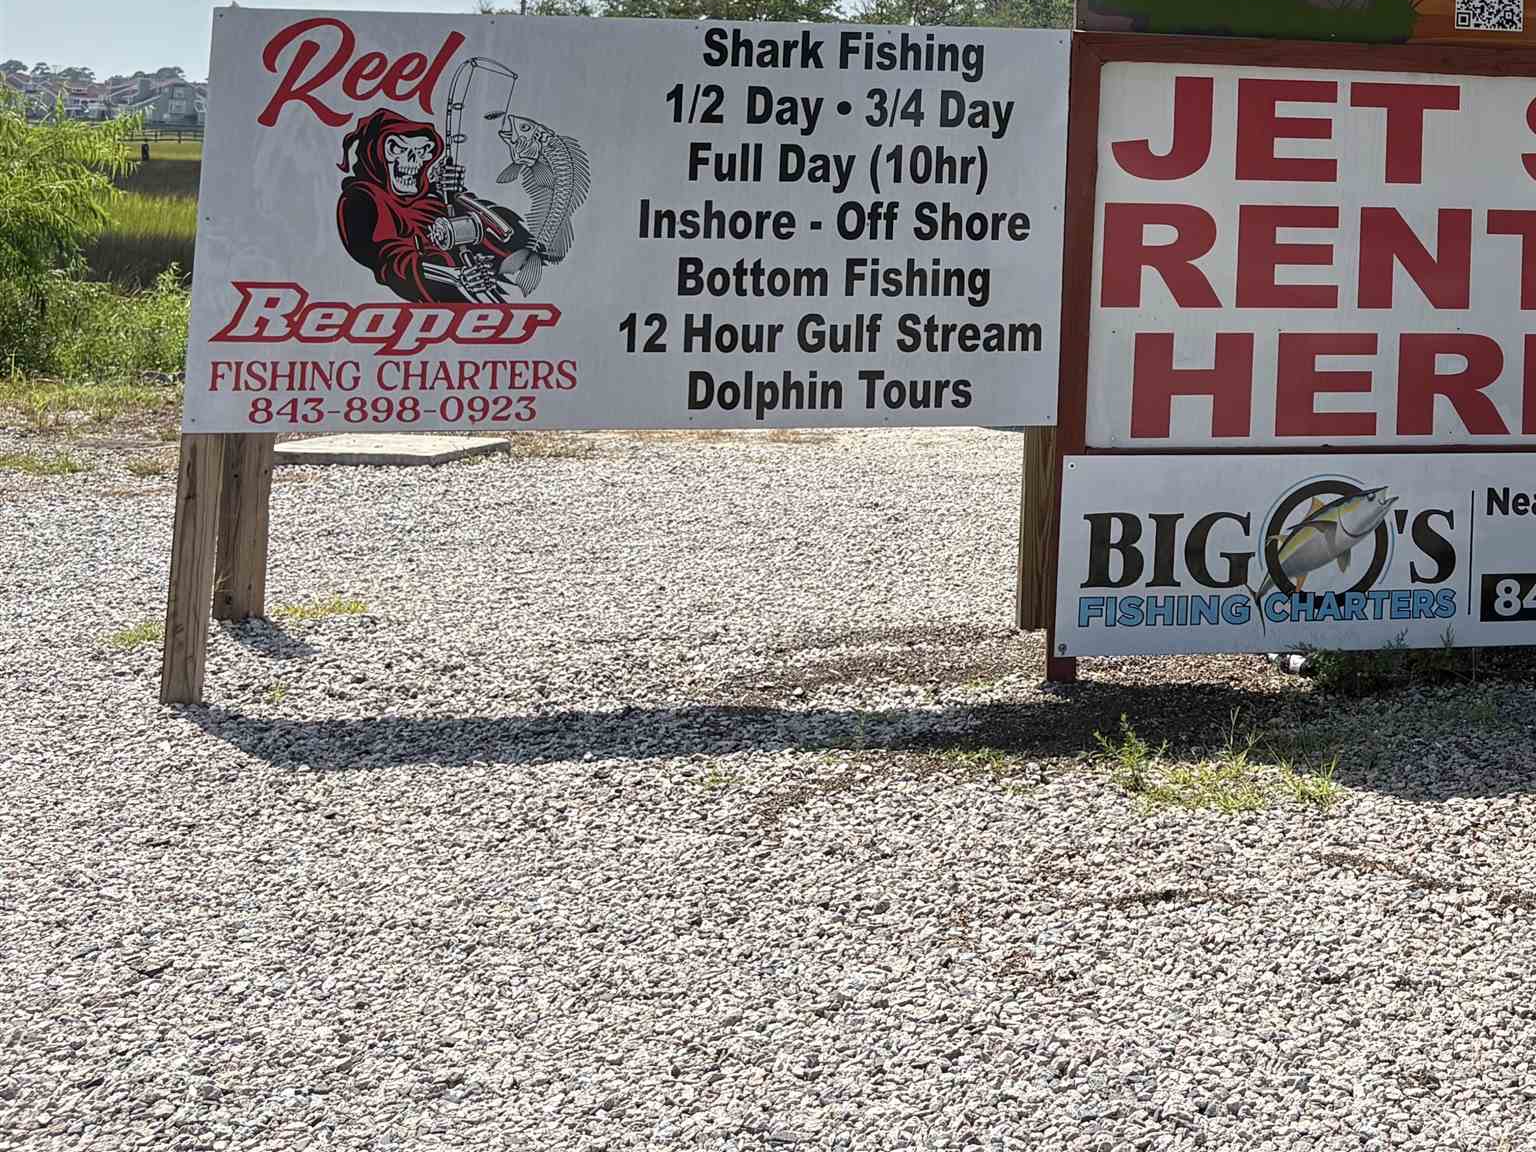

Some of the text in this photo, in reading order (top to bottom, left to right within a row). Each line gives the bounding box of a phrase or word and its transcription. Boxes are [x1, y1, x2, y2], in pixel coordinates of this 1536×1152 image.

[257, 17, 466, 127] Reel
[703, 27, 985, 82] Shark Fishing
[666, 83, 1015, 139] 1/2 Day 3/4 Day
[1110, 76, 1461, 184] JET
[688, 142, 988, 194] Full Day (10hr)
[639, 198, 796, 239] Inshore
[836, 201, 899, 240] Off
[913, 202, 1030, 241] Shore
[677, 257, 991, 306] Bottom Fishing
[208, 281, 562, 355] Reaper
[619, 312, 1042, 353] 12 Hour Gulf Stream
[208, 360, 577, 391] FISHING CHARTERS
[688, 370, 972, 420] Dolphin Tours
[248, 396, 536, 424] 843-898-0923
[1080, 512, 1255, 589] BIG
[1078, 589, 1457, 628] FISHING CHARTERS
